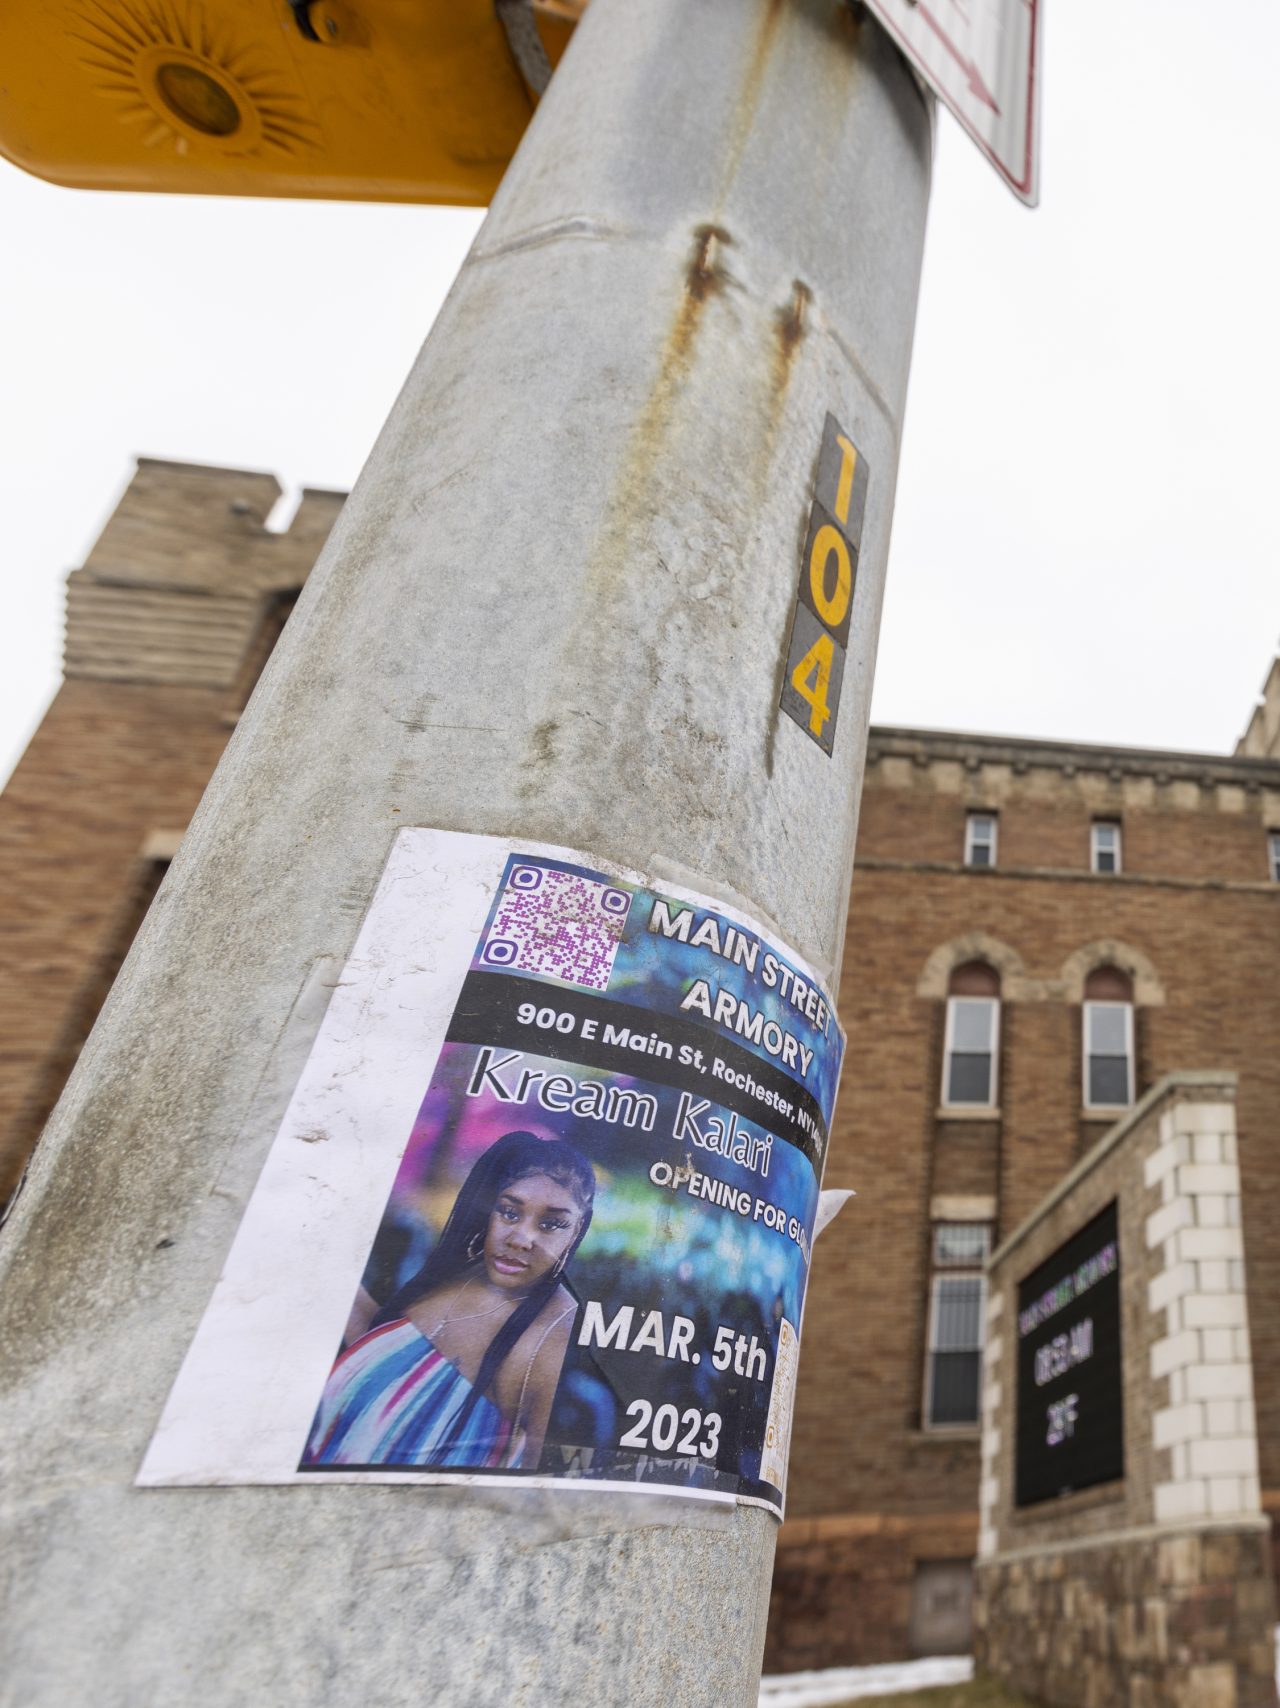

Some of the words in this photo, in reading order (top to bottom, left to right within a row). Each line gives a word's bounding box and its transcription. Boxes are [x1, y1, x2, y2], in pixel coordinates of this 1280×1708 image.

[791, 434, 857, 737] 104
[648, 900, 760, 974] MAIN
[762, 952, 832, 1040] STREET
[517, 1002, 576, 1035] 900
[580, 1019, 598, 1041] E
[602, 1023, 673, 1061] Main
[678, 1044, 709, 1076] St,
[711, 1057, 796, 1123] Rochester,
[680, 980, 814, 1078] ARMORY
[466, 1045, 658, 1131] Kream
[673, 1092, 773, 1176] Kalari
[650, 1161, 751, 1216] OPENING
[753, 1198, 787, 1234] FOR
[577, 1301, 701, 1365] MAR.
[711, 1326, 767, 1382] 5th
[619, 1399, 723, 1459] 2023
